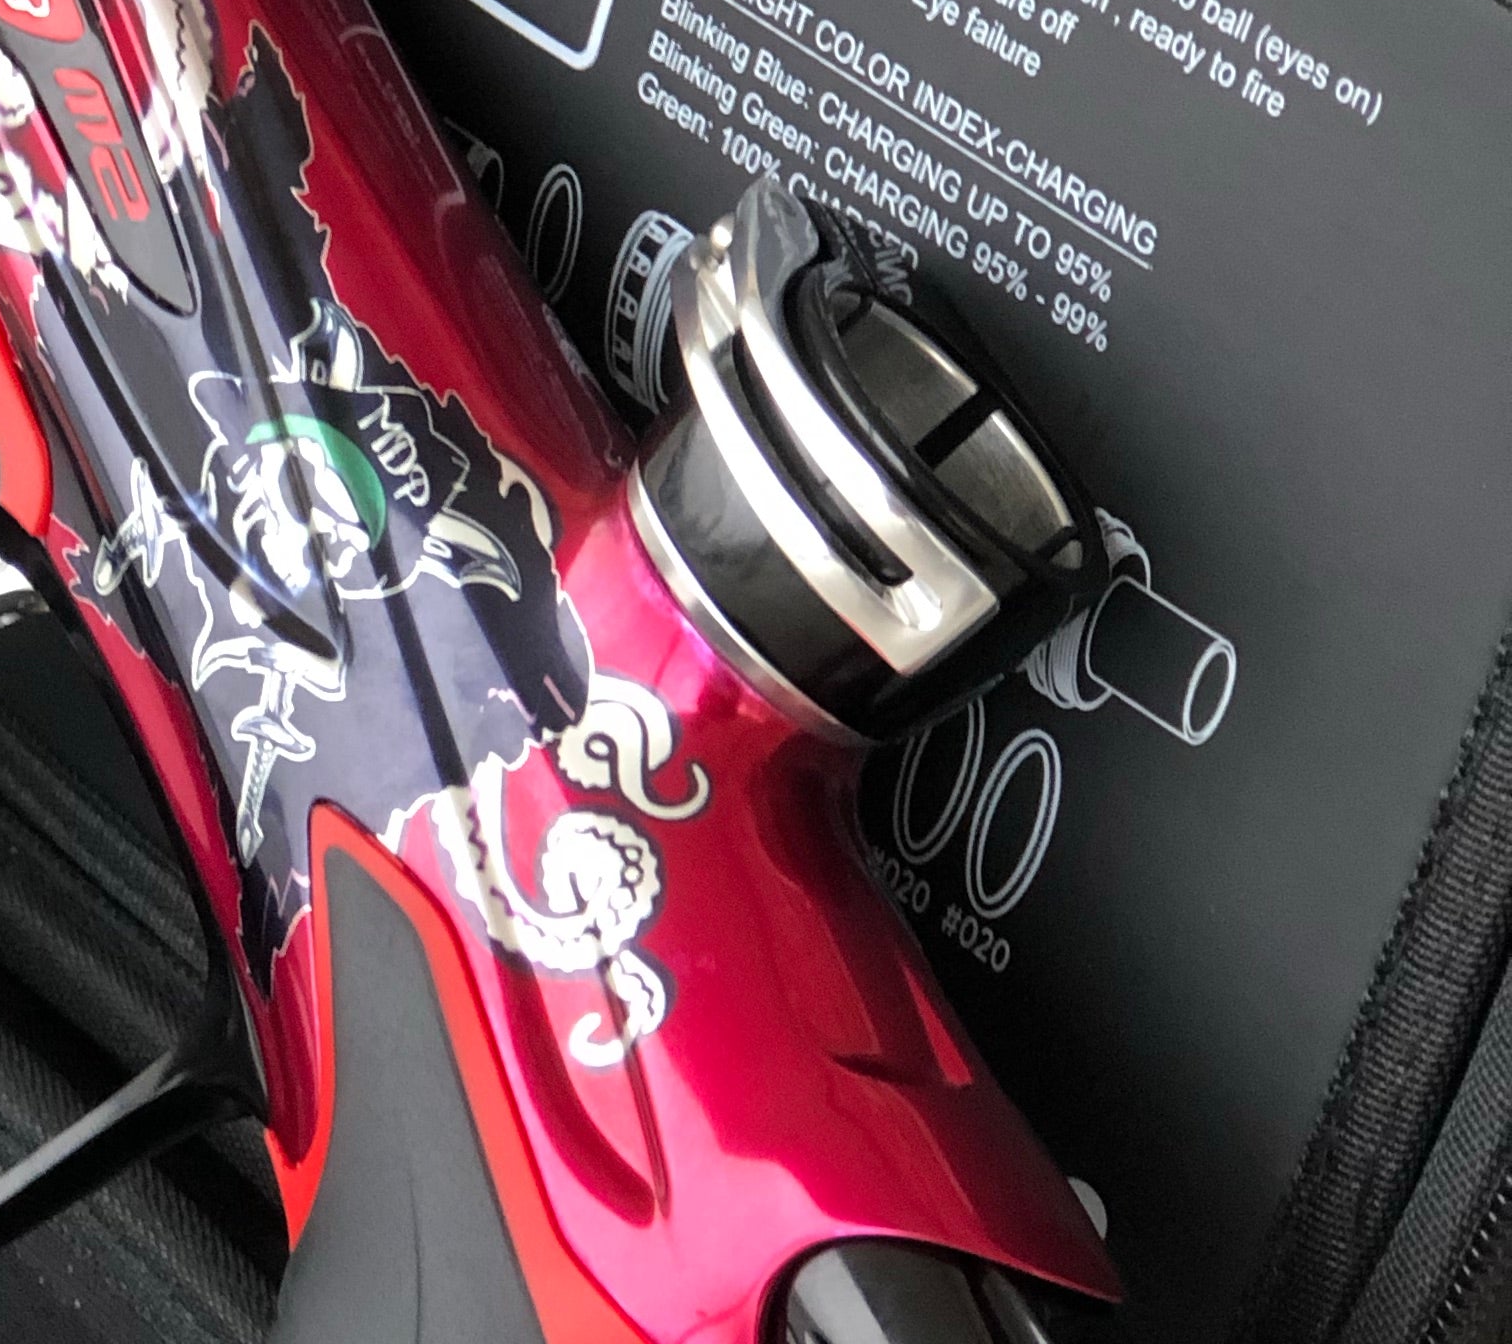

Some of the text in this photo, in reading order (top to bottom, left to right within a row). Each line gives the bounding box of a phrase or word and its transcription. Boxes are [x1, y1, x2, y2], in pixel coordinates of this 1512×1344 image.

[963, 6, 1041, 76] failure
[1039, 7, 1079, 44] off
[1128, 8, 1206, 74] ready
[1208, 50, 1236, 88] to
[1241, 67, 1285, 117] fire
[1254, 23, 1330, 89] (eyes
[1334, 76, 1382, 125] on)
[637, 71, 781, 187] Green: 100%
[752, 47, 813, 109] Blue:
[818, 91, 962, 203] CHARGING
[966, 183, 1008, 226] UP
[1014, 211, 1051, 259] TO
[1054, 242, 1111, 302] 95%
[814, 19, 910, 101] COLOR
[911, 79, 1157, 255] INDEX-CHARGING
[645, 29, 737, 114] Blinking
[741, 91, 820, 164] Green:
[824, 145, 968, 258] CHARGING
[972, 241, 1027, 300] 95%
[1050, 292, 1107, 351] 99%
[941, 902, 1011, 973] #020
